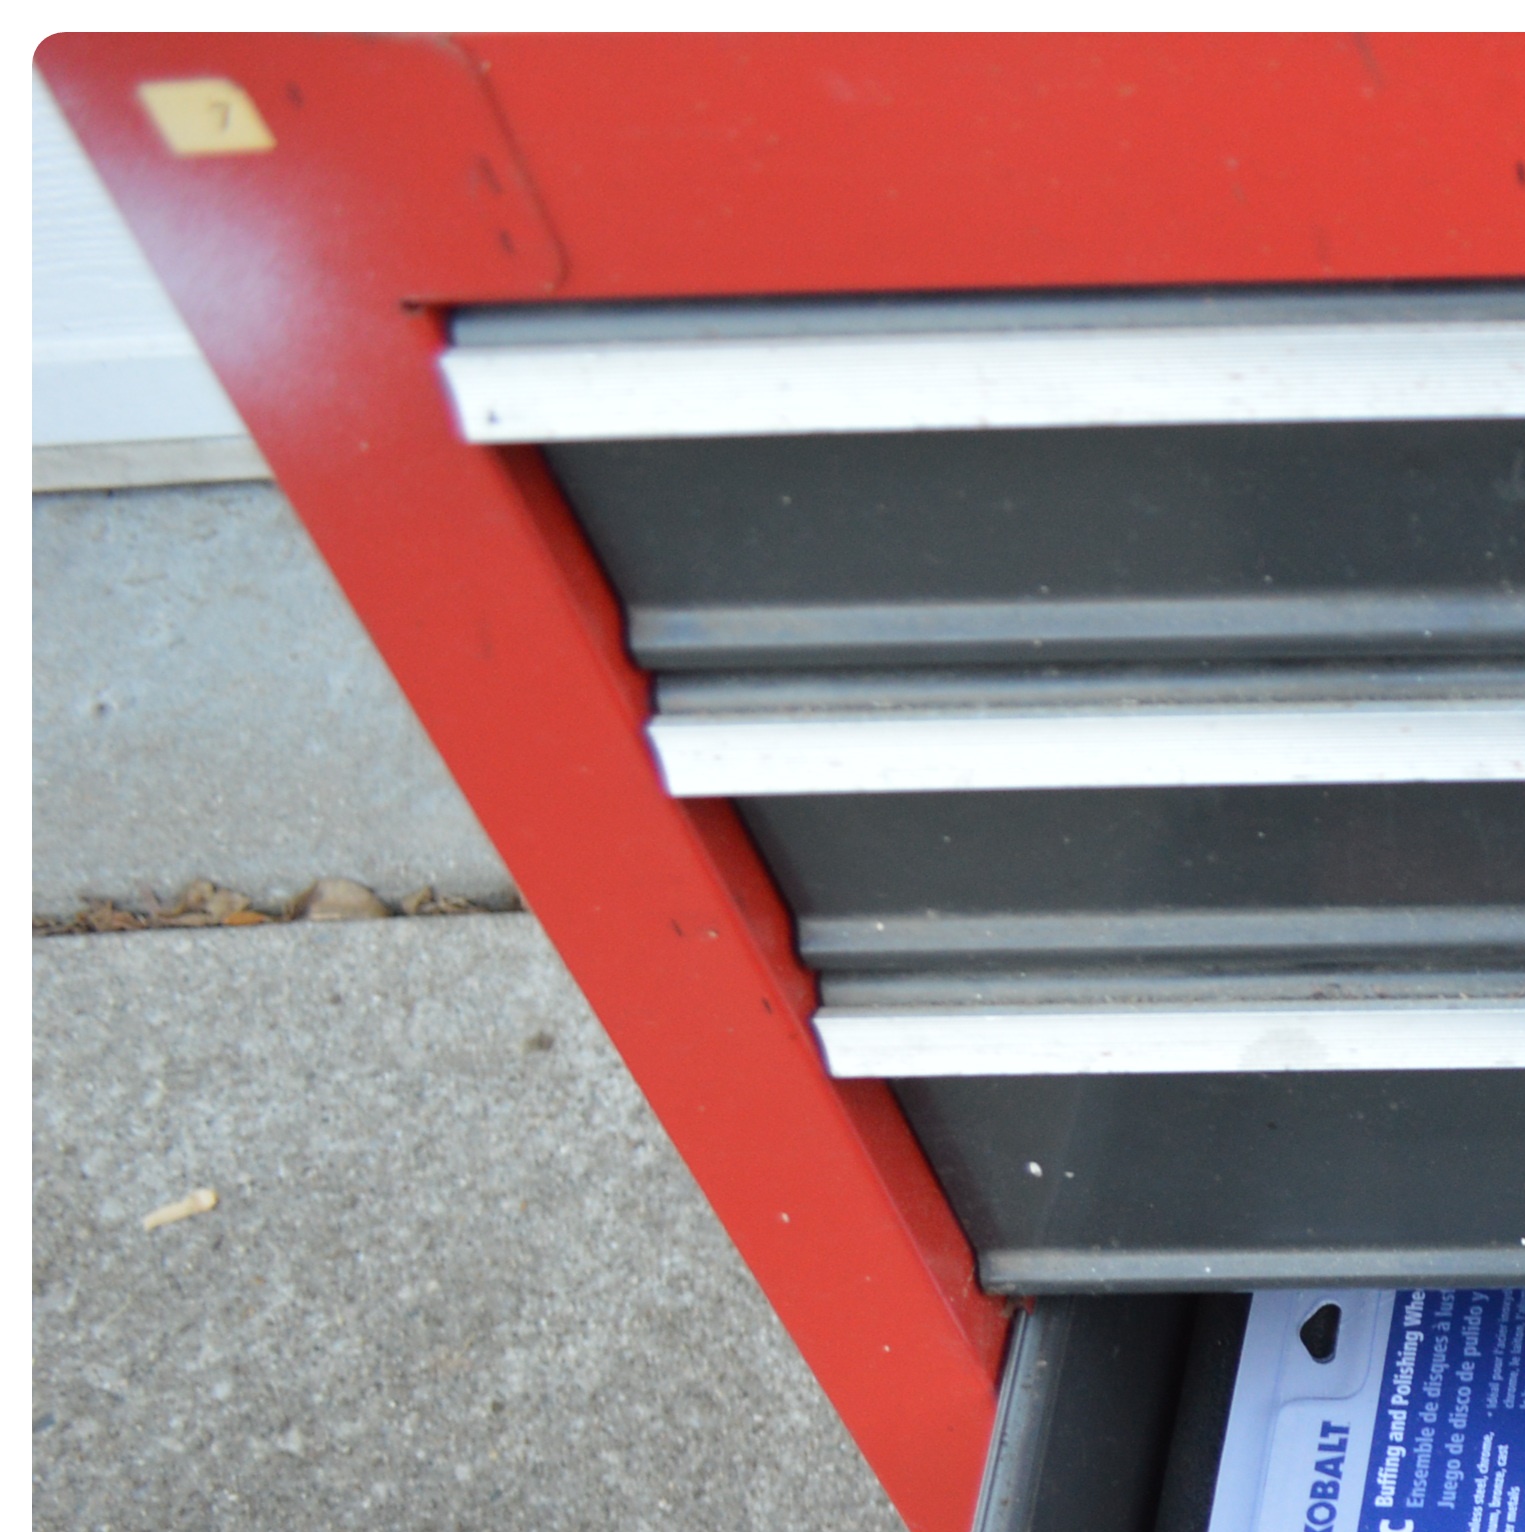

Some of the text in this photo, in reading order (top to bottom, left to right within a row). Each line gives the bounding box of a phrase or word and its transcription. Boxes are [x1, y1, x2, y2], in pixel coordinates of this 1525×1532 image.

[1392, 1331, 1424, 1406] Polishing
[1423, 1336, 1450, 1398] disques
[1492, 1356, 1503, 1381] pour
[1420, 1402, 1438, 1423] de
[1437, 1291, 1490, 1509] Juego de disco de pulido y
[1389, 1410, 1407, 1442] and
[1374, 1446, 1406, 1507] Buffing
[1406, 1427, 1435, 1508] Ensemble
[1477, 1432, 1494, 1474] chrome,
[1488, 1468, 1506, 1507] bronze,
[1497, 1445, 1508, 1467] cast
[1474, 1476, 1488, 1504] steel,
[1507, 1486, 1520, 1522] metals
